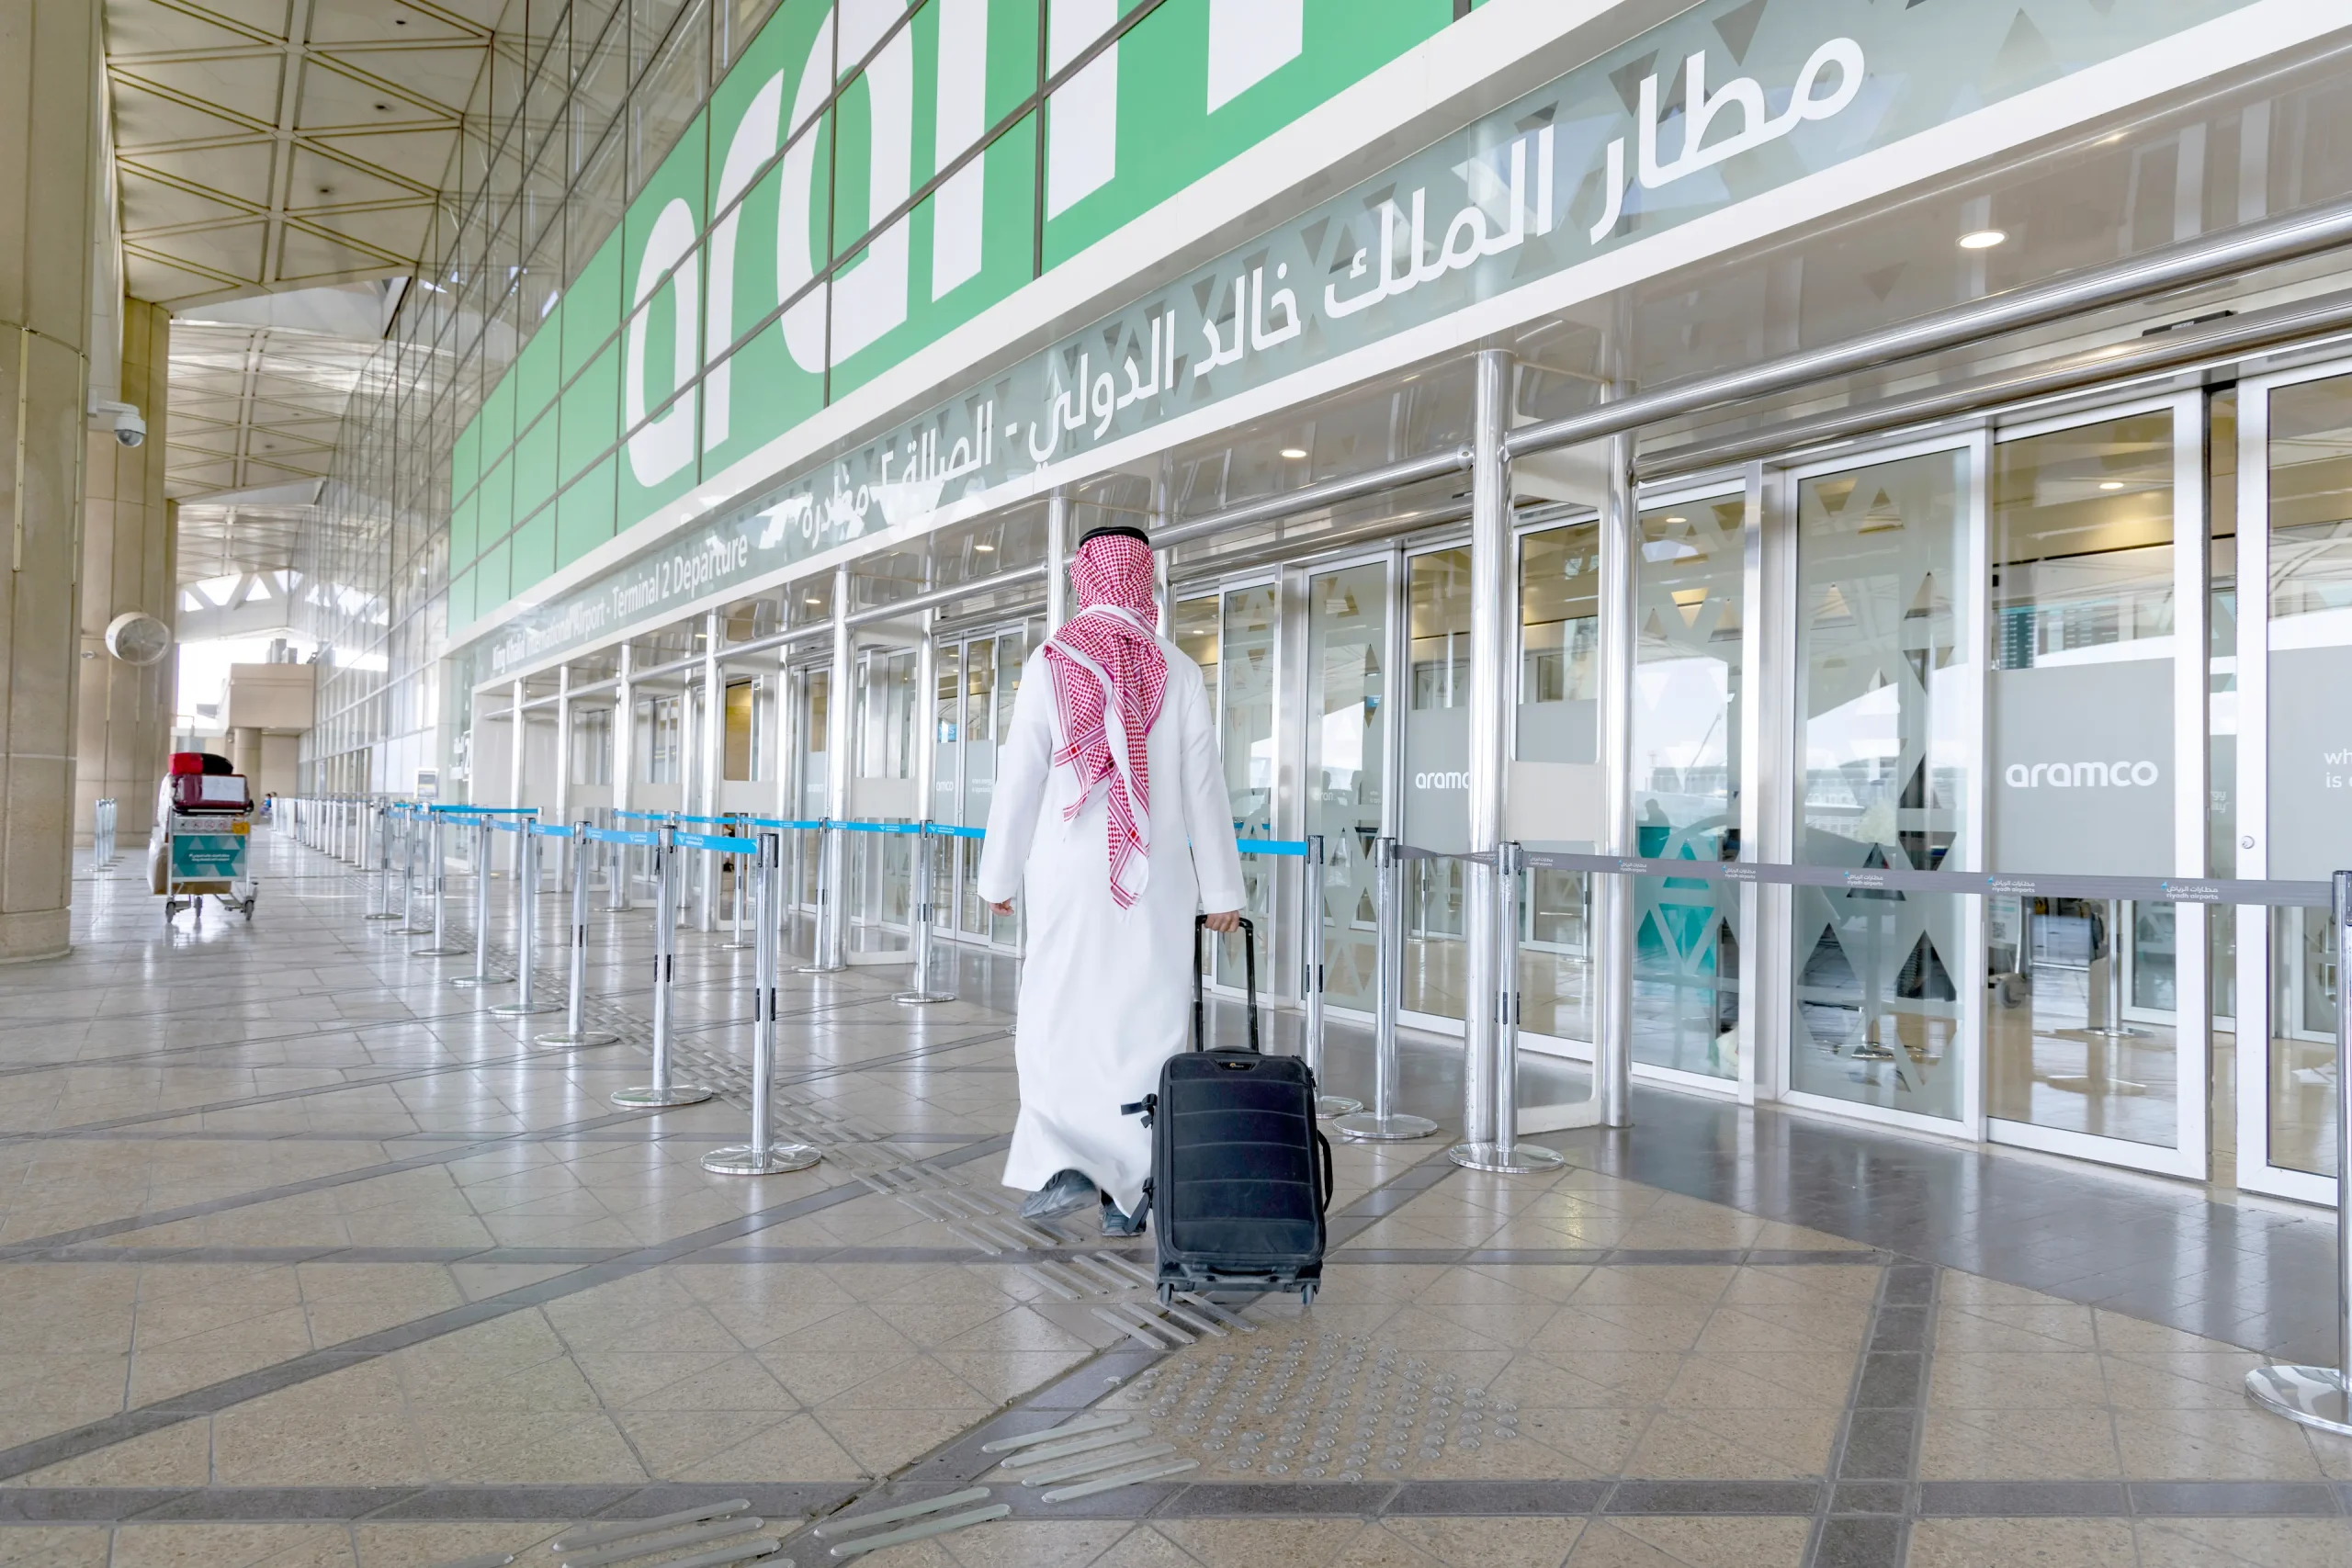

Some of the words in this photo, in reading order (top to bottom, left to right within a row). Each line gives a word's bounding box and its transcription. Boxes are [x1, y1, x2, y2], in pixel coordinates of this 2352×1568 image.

[1589, 37, 1865, 245] مطار
[1324, 123, 1555, 319] الملك
[1193, 263, 1302, 378] خالد
[1028, 310, 1175, 470] الدولي
[613, 562, 659, 620] Terminal
[662, 560, 670, 598] 2
[673, 535, 747, 599] Departure
[1416, 772, 1470, 789] aramc
[2006, 761, 2159, 788] aramco
